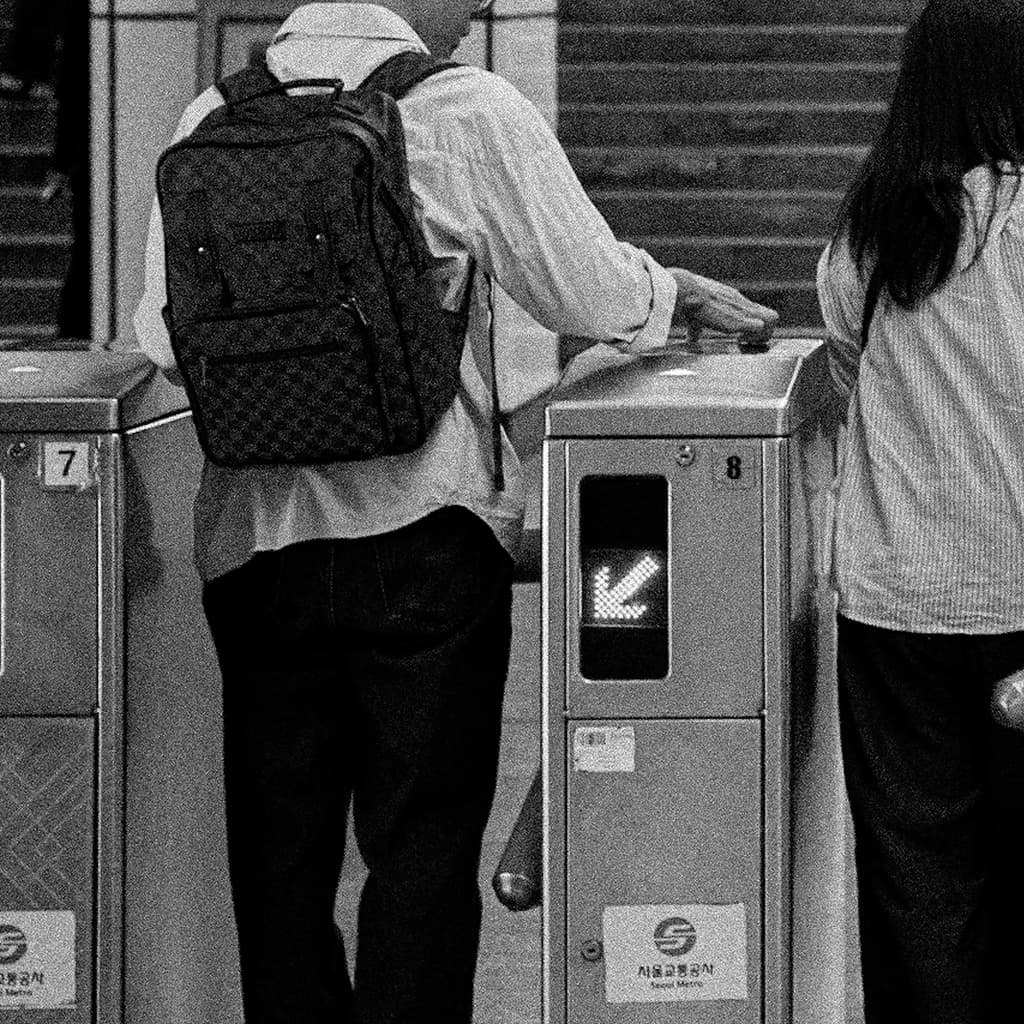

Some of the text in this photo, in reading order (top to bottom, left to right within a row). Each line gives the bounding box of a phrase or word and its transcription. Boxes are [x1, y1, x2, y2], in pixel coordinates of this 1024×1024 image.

[58, 450, 77, 476] 7
[726, 455, 742, 480] 8
[638, 963, 714, 979] 서울교통공사
